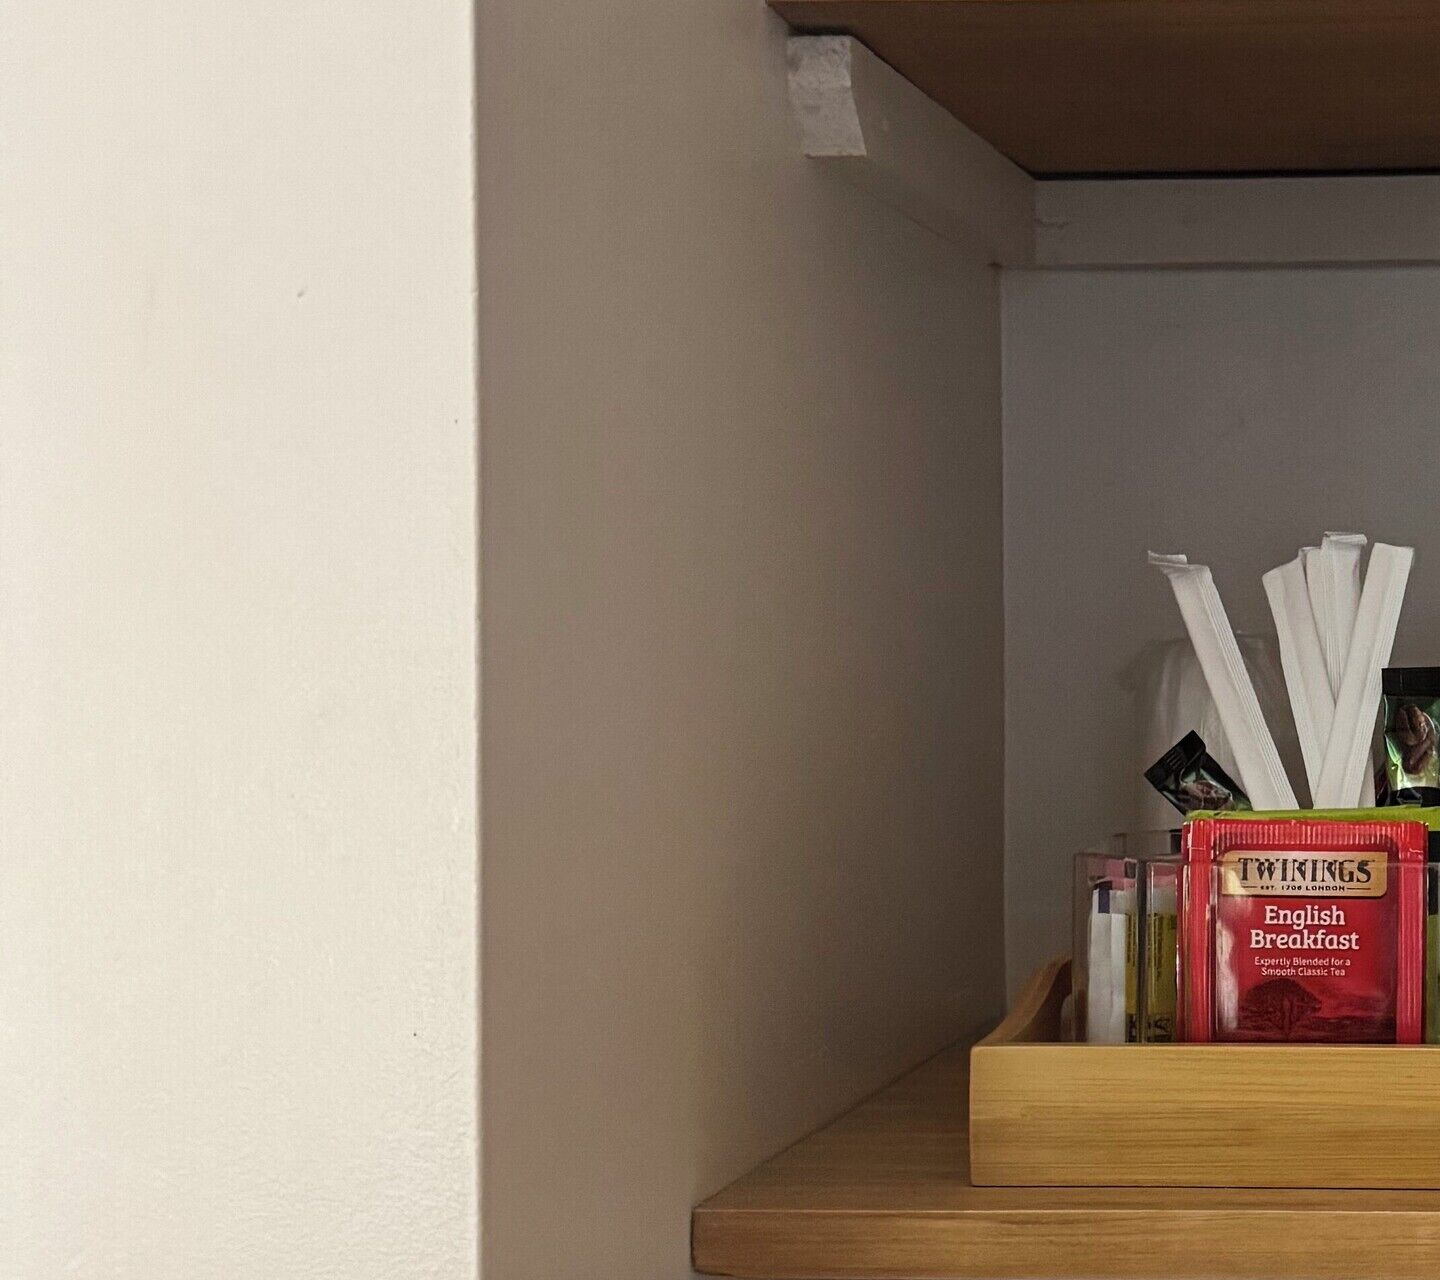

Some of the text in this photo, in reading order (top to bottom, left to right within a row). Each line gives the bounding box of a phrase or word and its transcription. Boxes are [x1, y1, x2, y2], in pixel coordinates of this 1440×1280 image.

[1238, 858, 1376, 883] TWININGS
[1264, 905, 1345, 930] English
[1250, 929, 1360, 950] Breakfast
[1254, 957, 1291, 967] Expertly
[1293, 957, 1329, 966] Blended
[1331, 958, 1343, 966] for
[1262, 967, 1345, 976] Smooth Classic Tea
